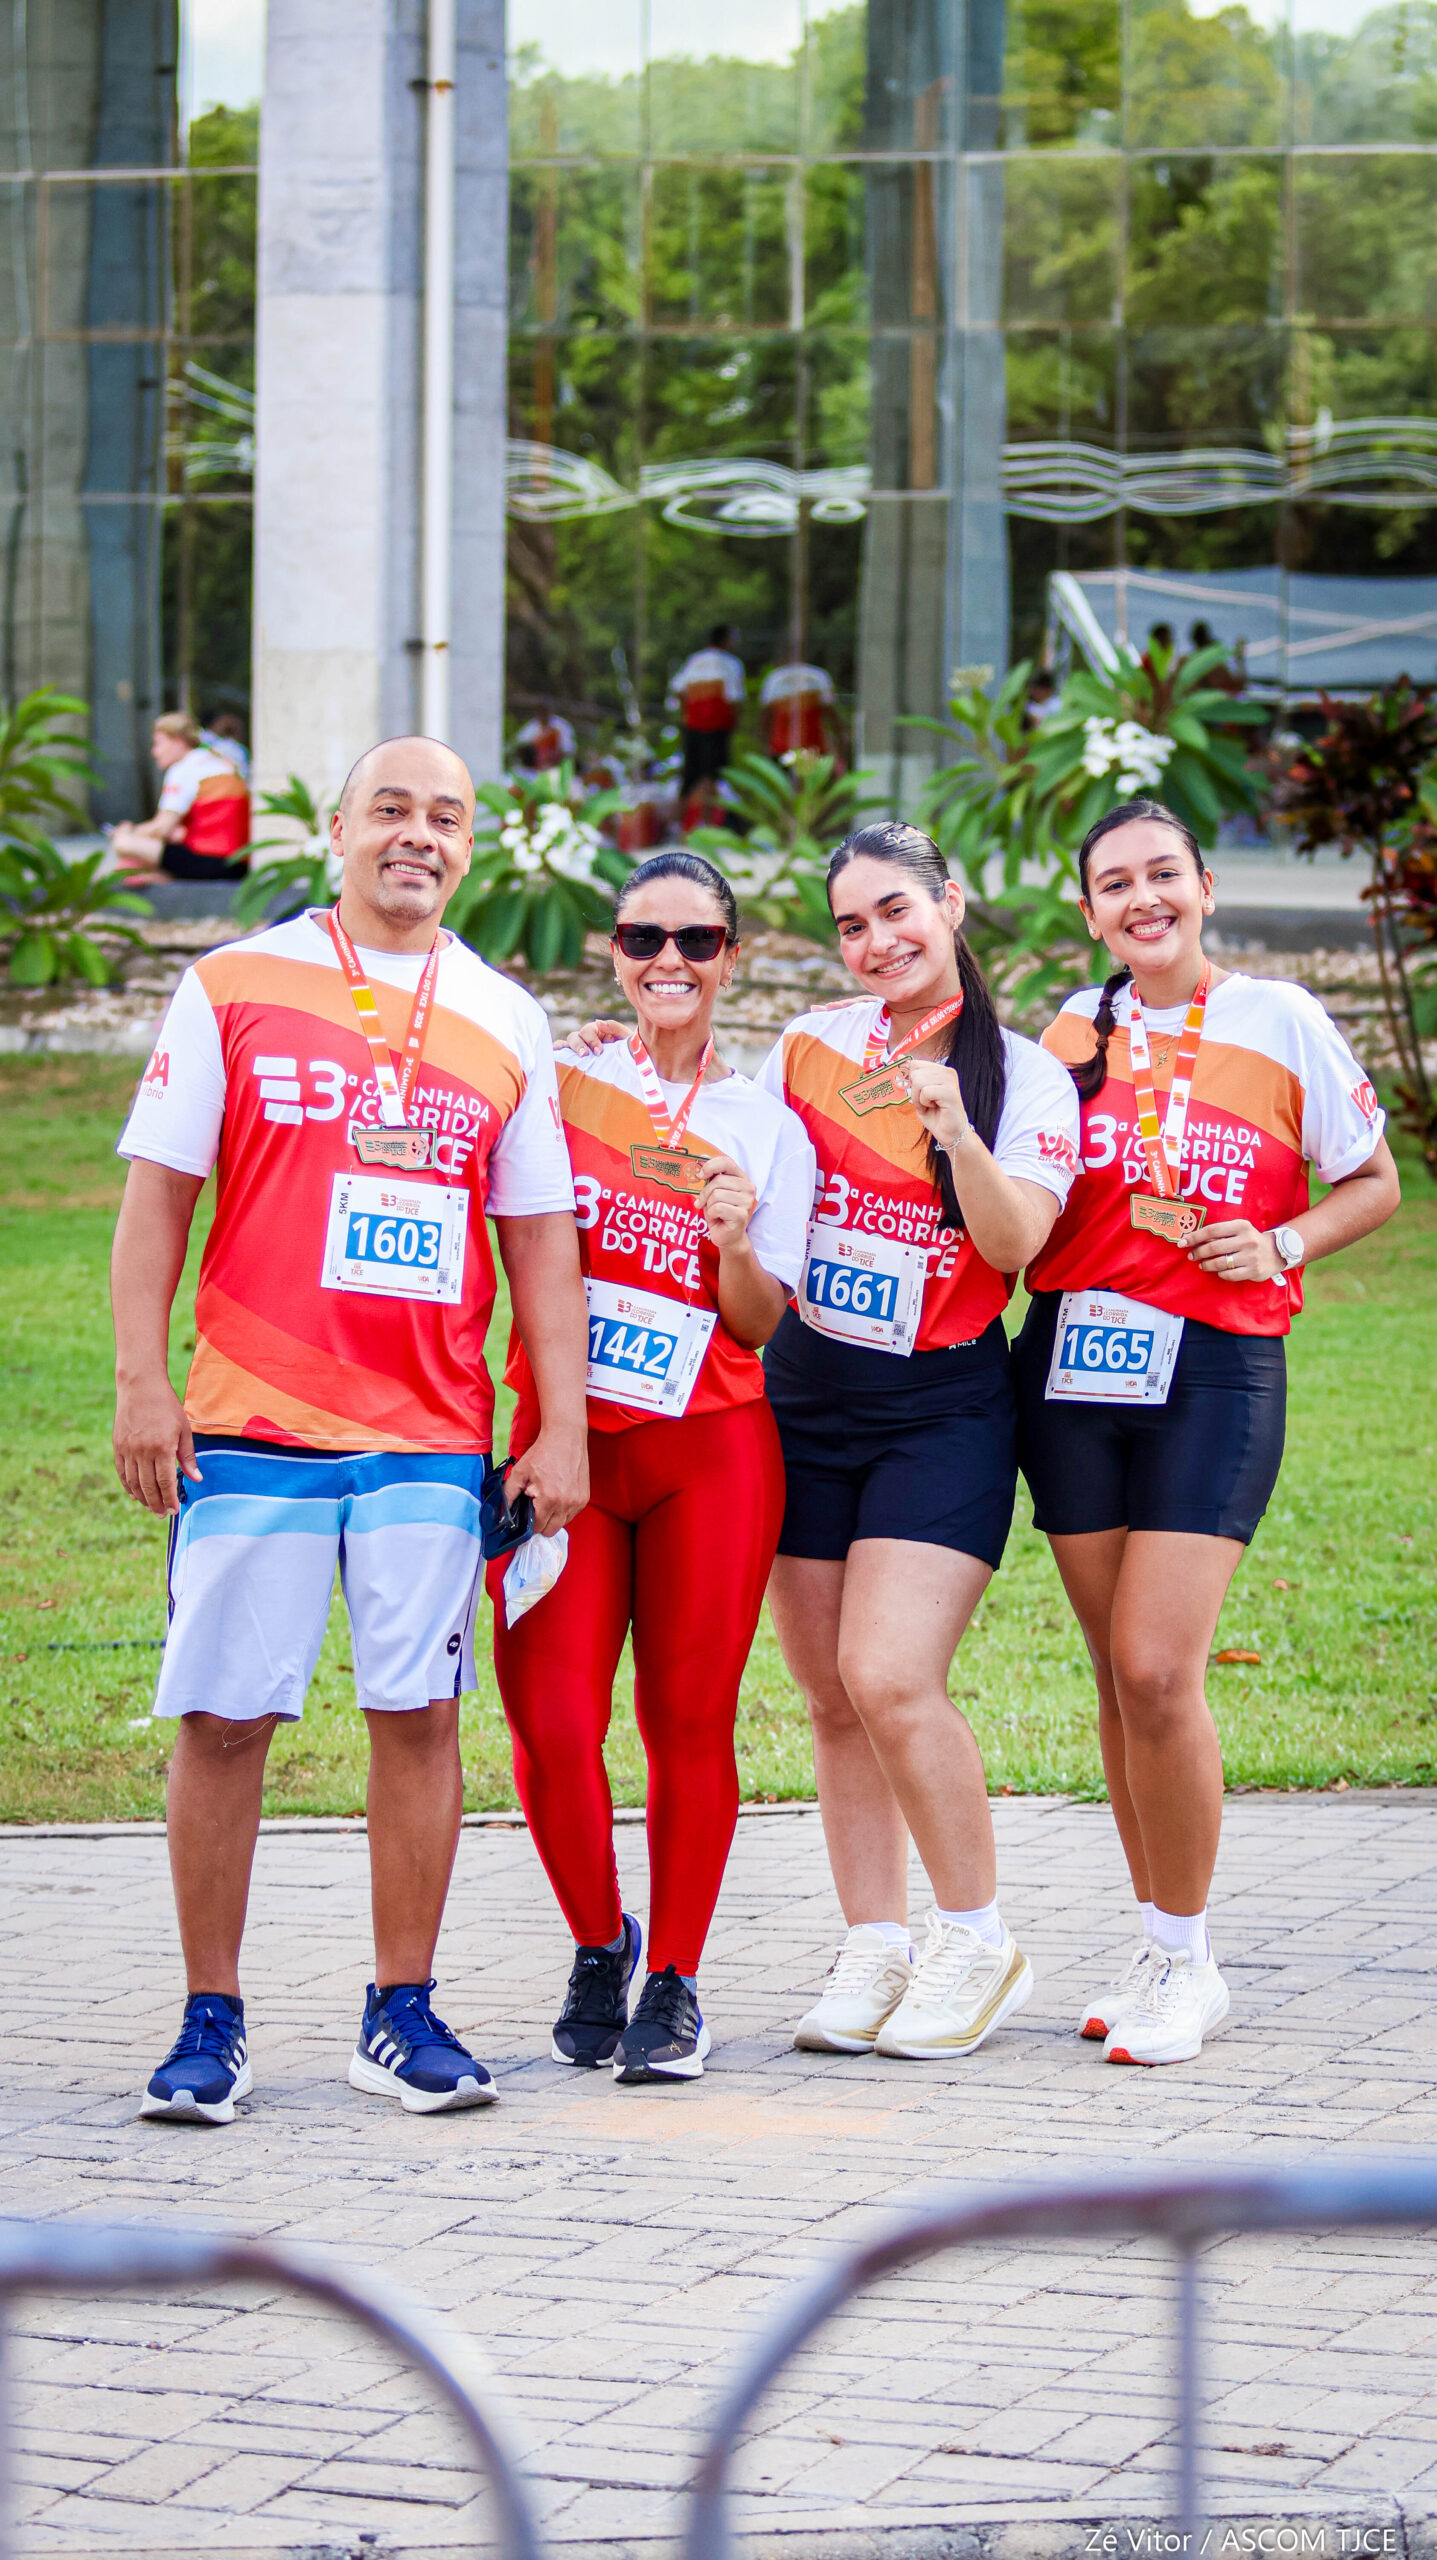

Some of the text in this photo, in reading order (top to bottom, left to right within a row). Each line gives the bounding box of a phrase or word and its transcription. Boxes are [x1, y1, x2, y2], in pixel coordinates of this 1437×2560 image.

[362, 1079, 489, 1123] CAINHADA
[338, 1192, 349, 1215] 5KM
[863, 1192, 943, 1222] CAMINH
[352, 1216, 439, 1265] 1603
[604, 1206, 701, 1251] /CORRID
[602, 1227, 701, 1290] DO TJCE
[812, 1263, 892, 1317] 1661
[590, 1321, 673, 1376] 1442
[1066, 1328, 1150, 1371] 1665
